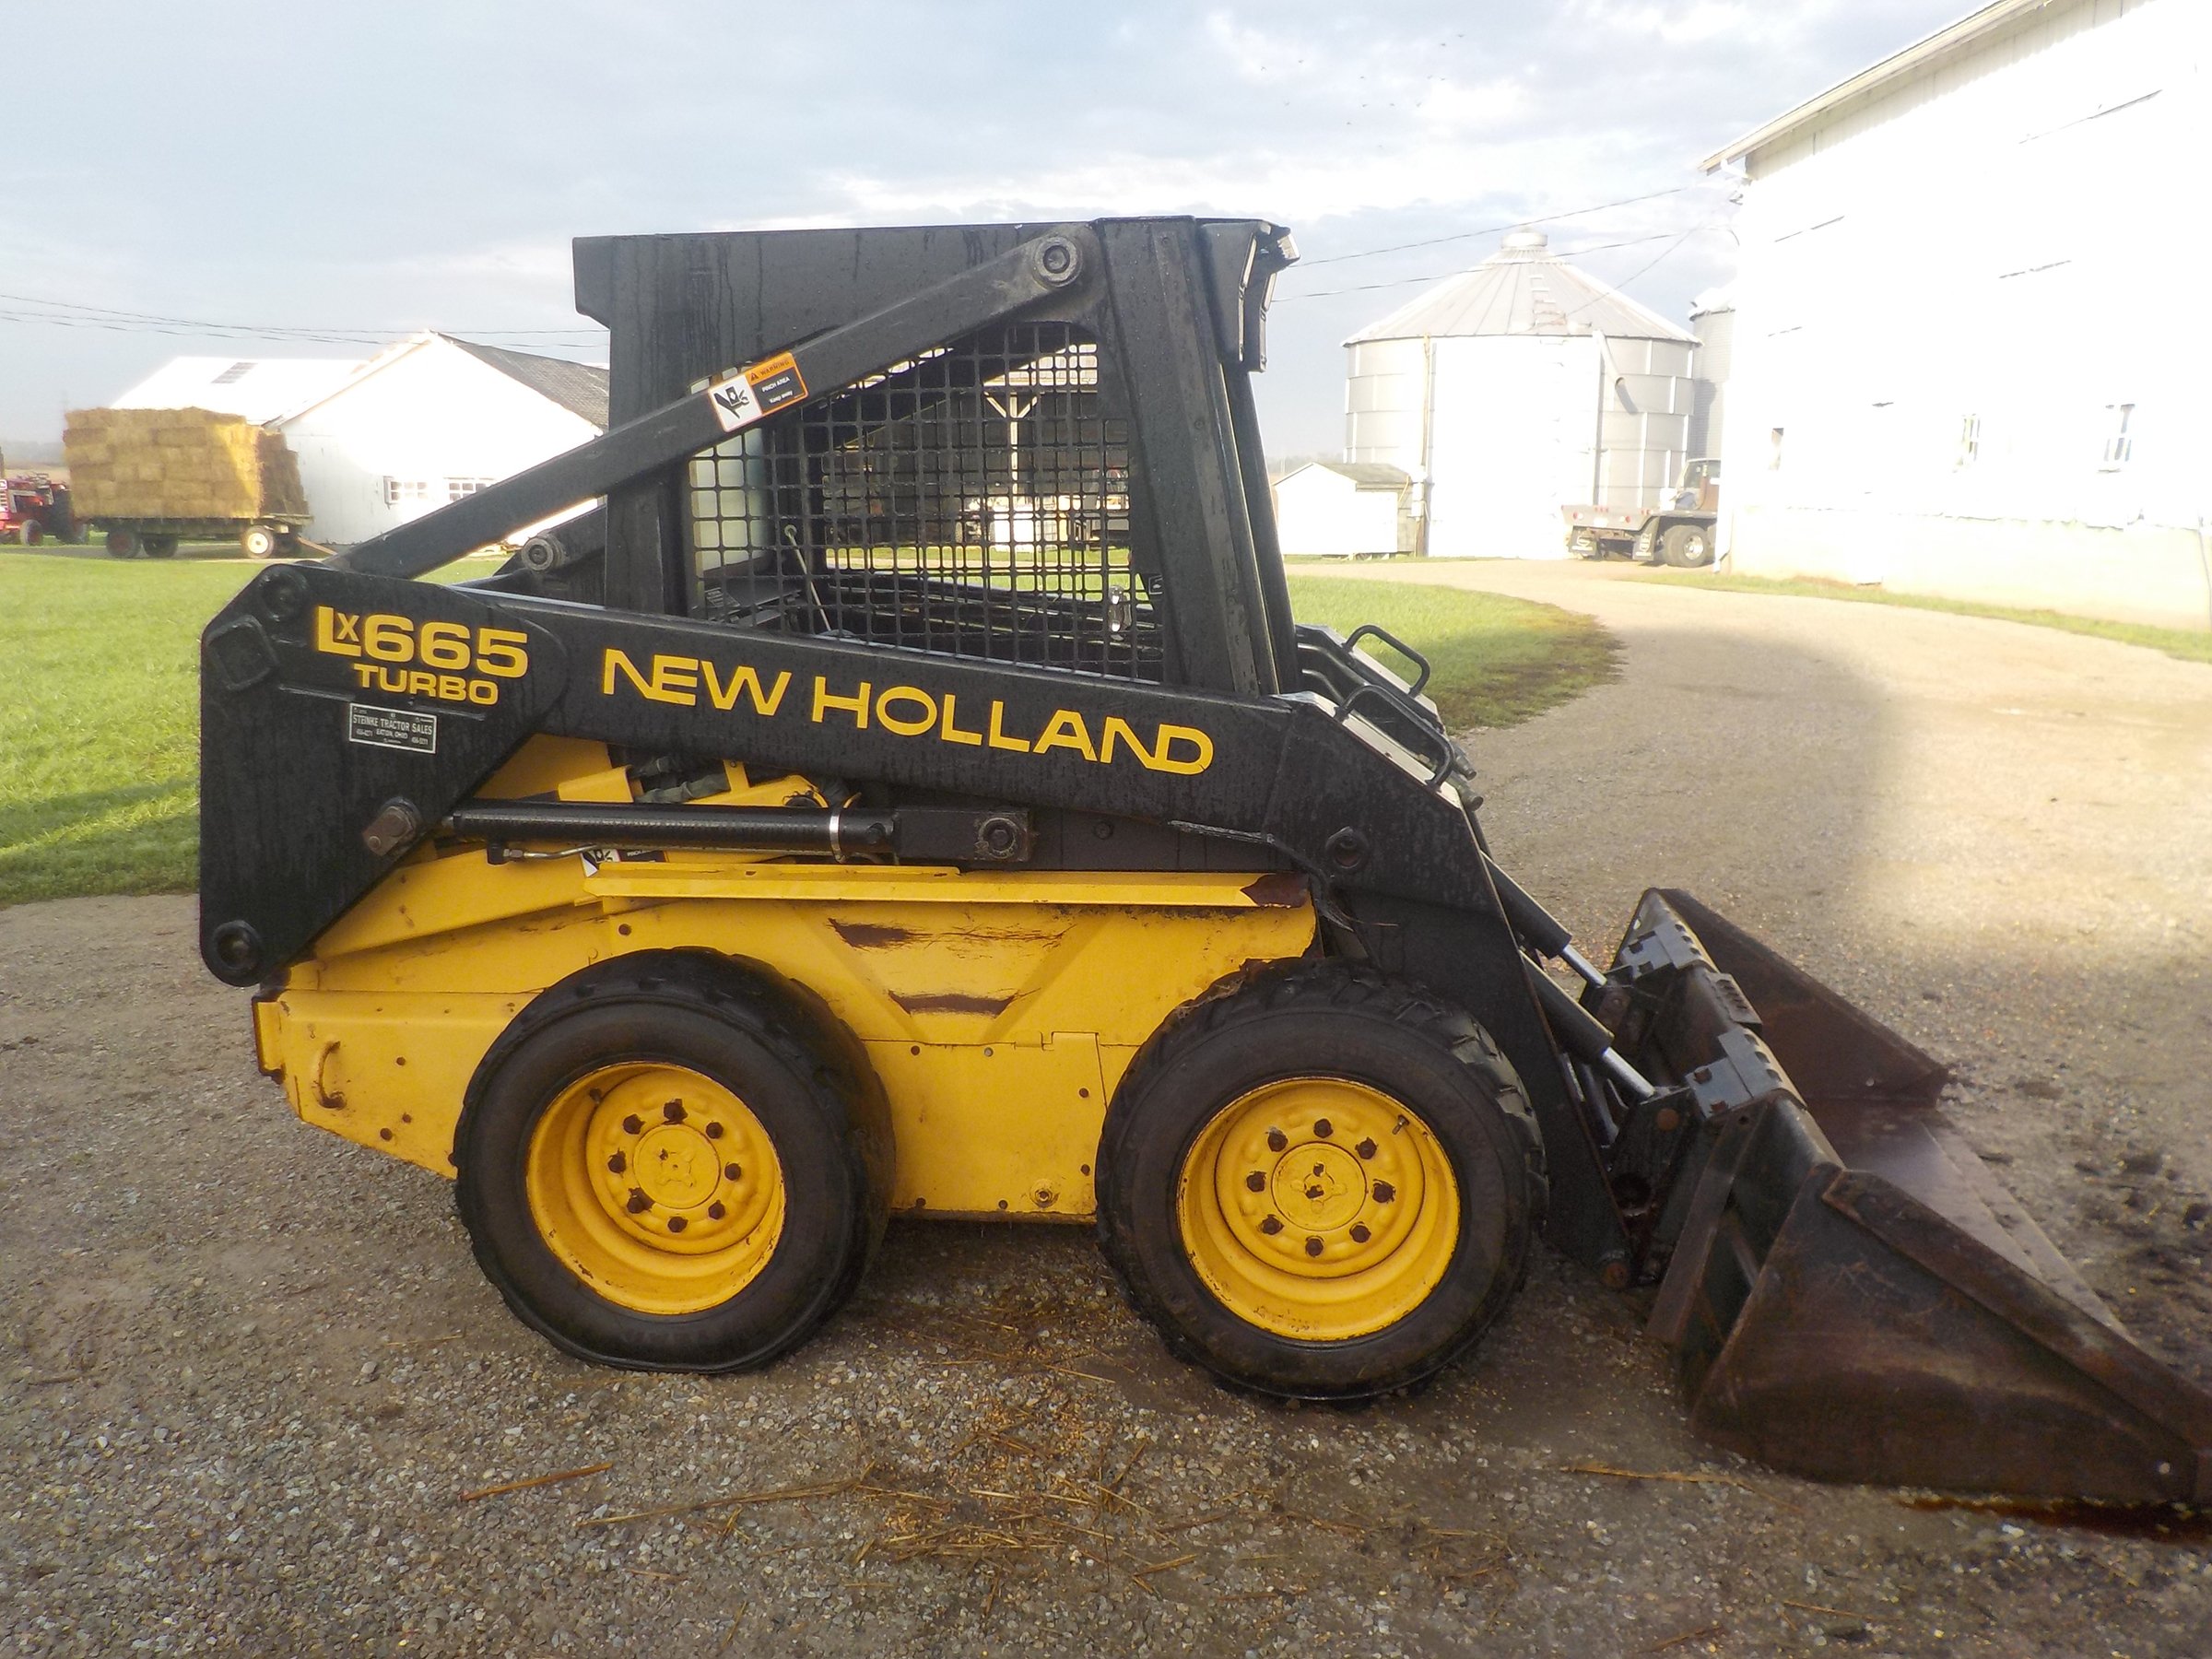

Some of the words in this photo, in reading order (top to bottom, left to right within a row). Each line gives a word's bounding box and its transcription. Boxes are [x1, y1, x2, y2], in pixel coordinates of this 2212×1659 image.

[760, 360, 790, 376] WARNING
[776, 376, 790, 386] AREA
[353, 663, 499, 705] TURBO
[603, 648, 792, 716] NEW
[812, 676, 1214, 775] HOLLAND
[380, 718, 410, 732] TRACTOR
[412, 723, 432, 735] SALES
